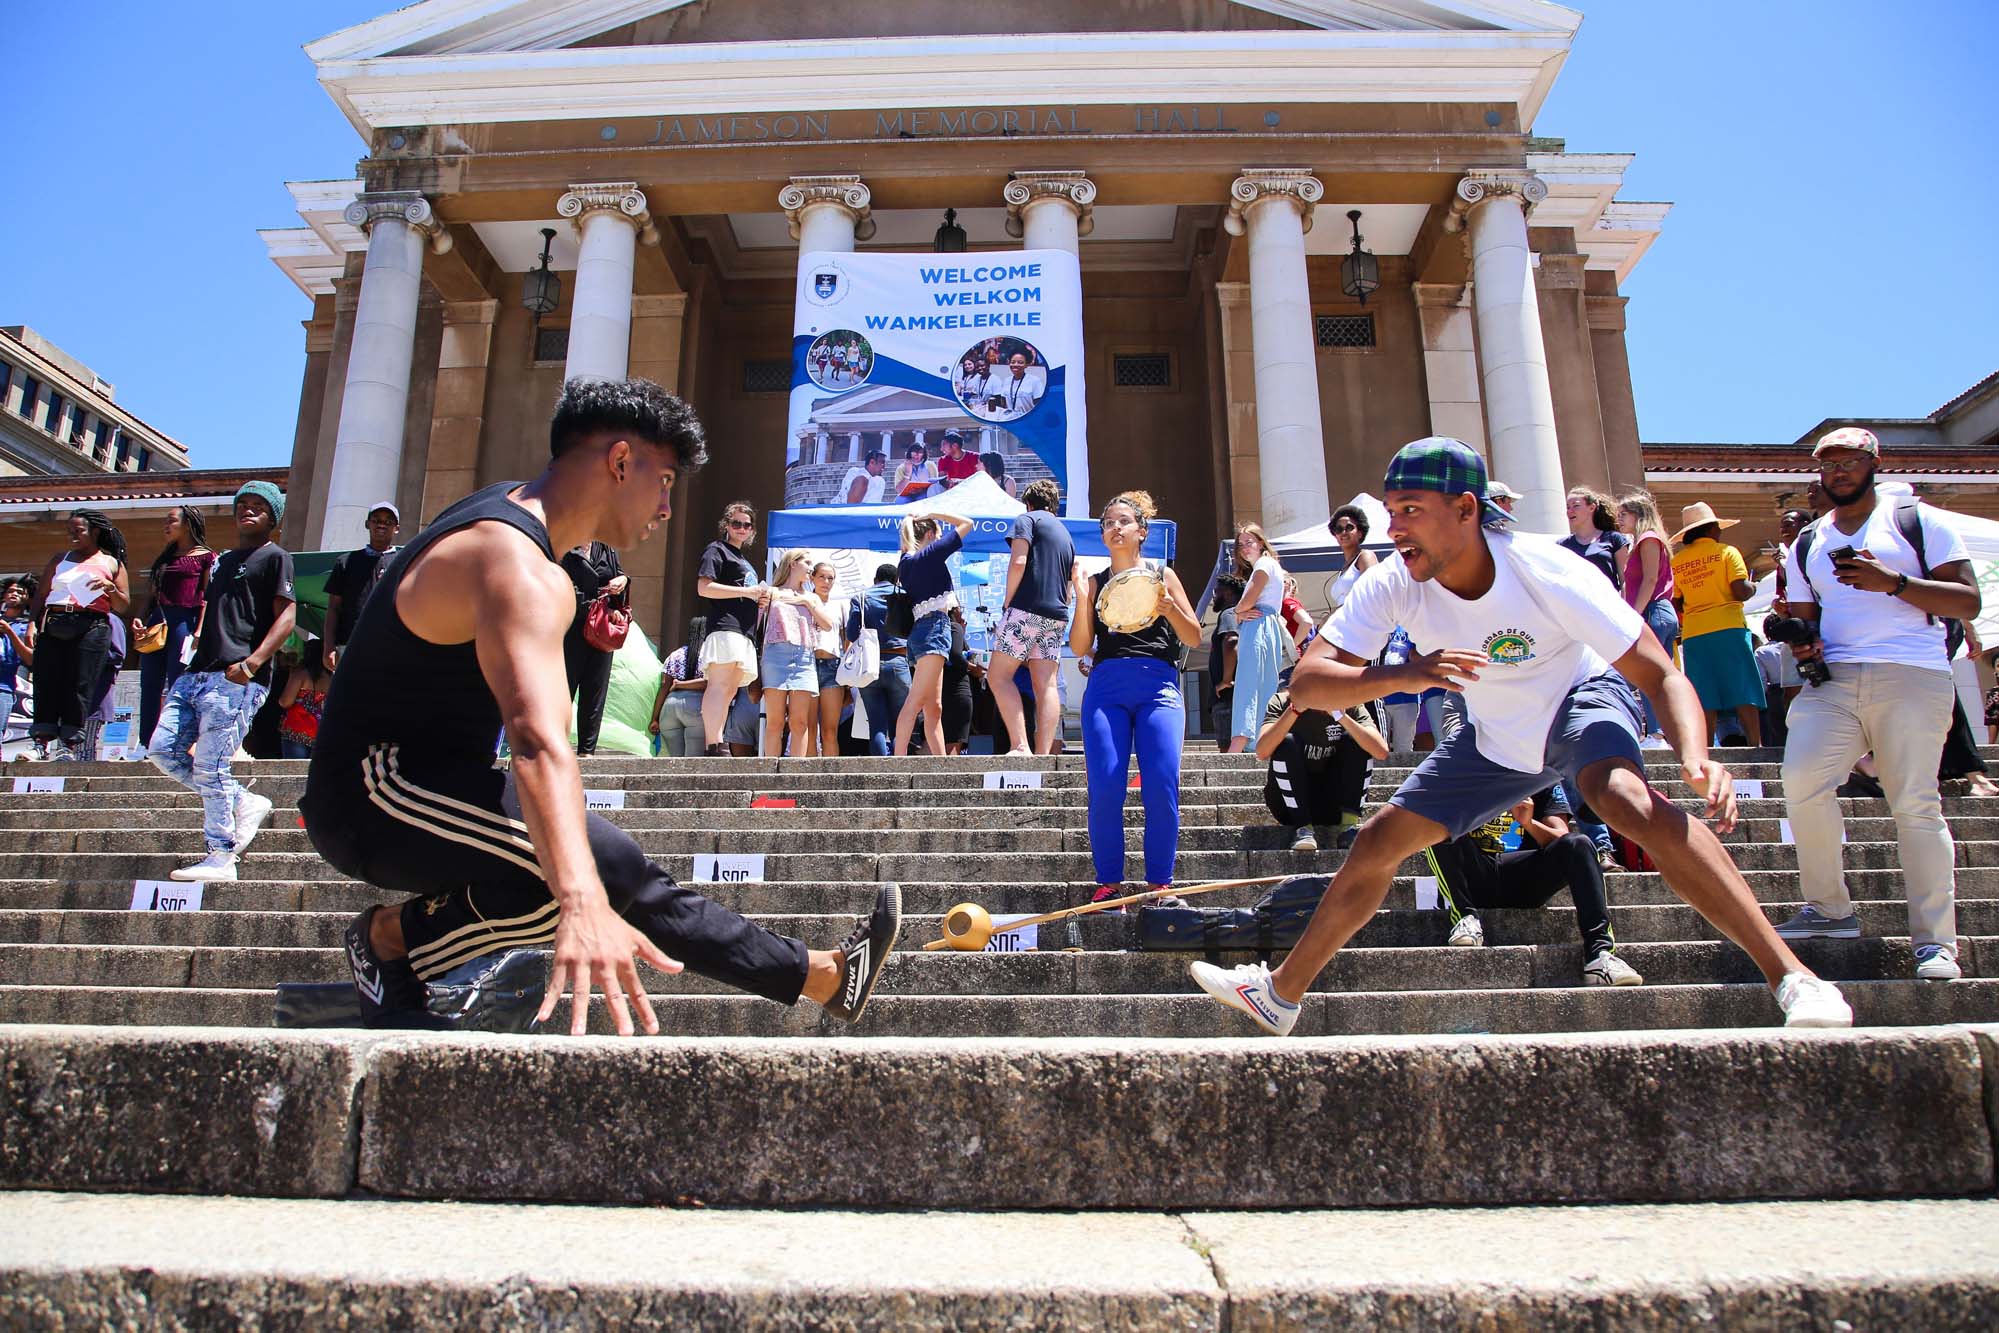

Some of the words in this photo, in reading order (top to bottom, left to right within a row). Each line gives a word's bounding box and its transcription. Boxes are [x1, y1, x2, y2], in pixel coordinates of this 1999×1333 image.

[649, 112, 829, 143] JAMESON
[875, 109, 1091, 136] MEMORIAL
[1134, 106, 1237, 132] HALL
[920, 264, 1042, 284] WELCOME
[934, 287, 1042, 306] WELKOM
[865, 312, 1042, 330] WAMKELEKILE
[1702, 553, 1720, 565] LIFE
